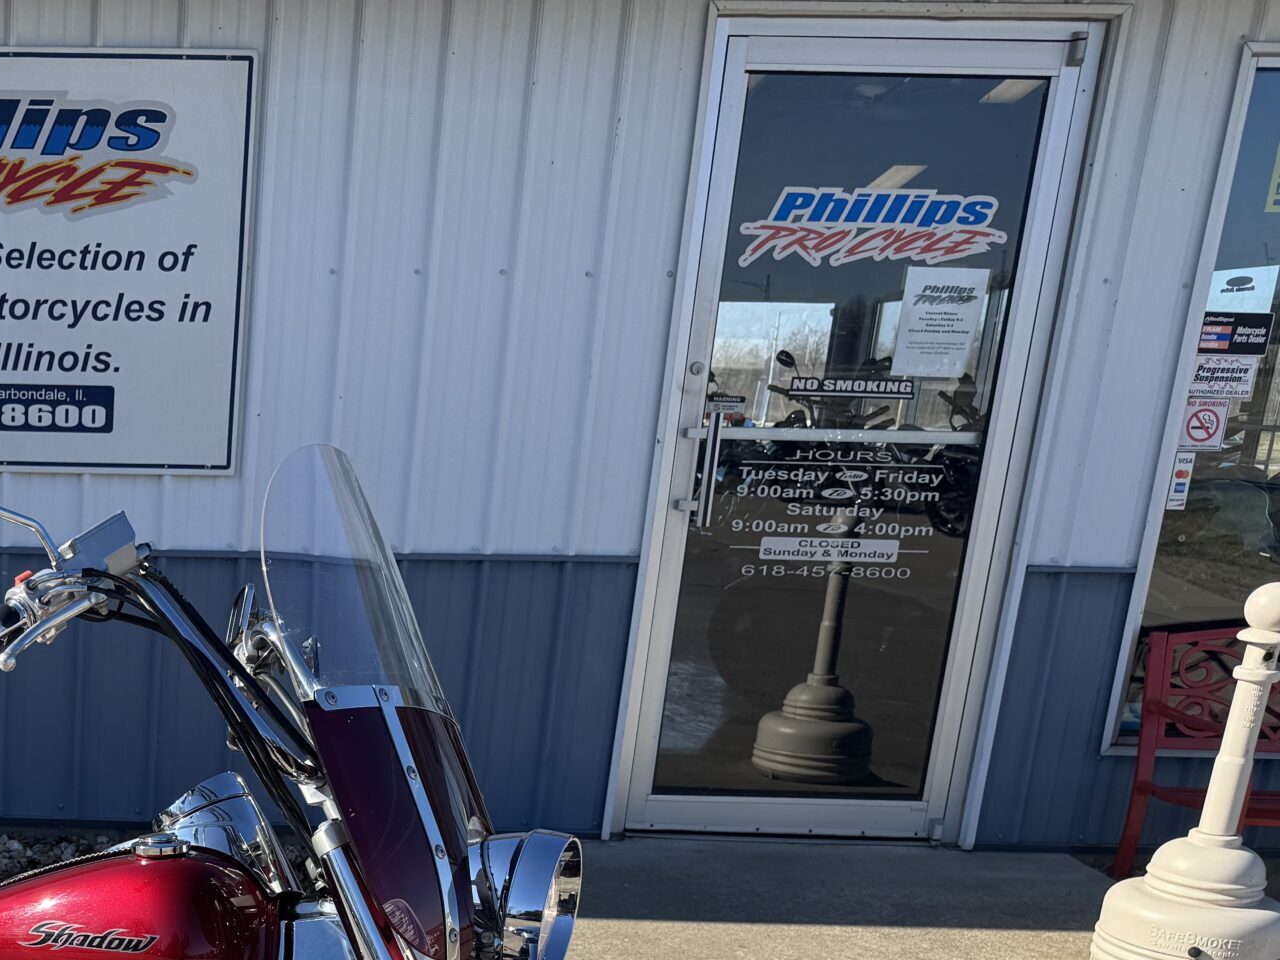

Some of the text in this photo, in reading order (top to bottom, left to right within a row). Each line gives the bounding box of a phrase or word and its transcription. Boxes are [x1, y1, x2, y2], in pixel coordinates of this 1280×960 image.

[772, 192, 994, 227] Phillips
[743, 224, 1002, 262] PRO CYCLE
[158, 244, 198, 272] of
[177, 294, 212, 323] in
[1235, 326, 1267, 337] Motorcycle
[1233, 335, 1267, 344] Parts Dealer
[1196, 365, 1250, 375] Progressive
[792, 378, 913, 393] NO SMOKING
[1193, 374, 1243, 384] Suspension
[1197, 400, 1228, 408] SMOKING
[795, 449, 892, 462] HOURS
[739, 466, 830, 485] Tuesday
[874, 469, 944, 487] Friday
[736, 484, 814, 498] 9:00am
[860, 486, 940, 504] 5:30pm
[786, 502, 885, 520] Saturday
[731, 519, 809, 533] 9:00am
[853, 522, 934, 538] 4:00pm
[798, 539, 861, 549] CLOSED
[762, 547, 894, 560] Sunday & Monday
[741, 564, 911, 579] 618-457-8600
[16, 920, 160, 953] Shadow
